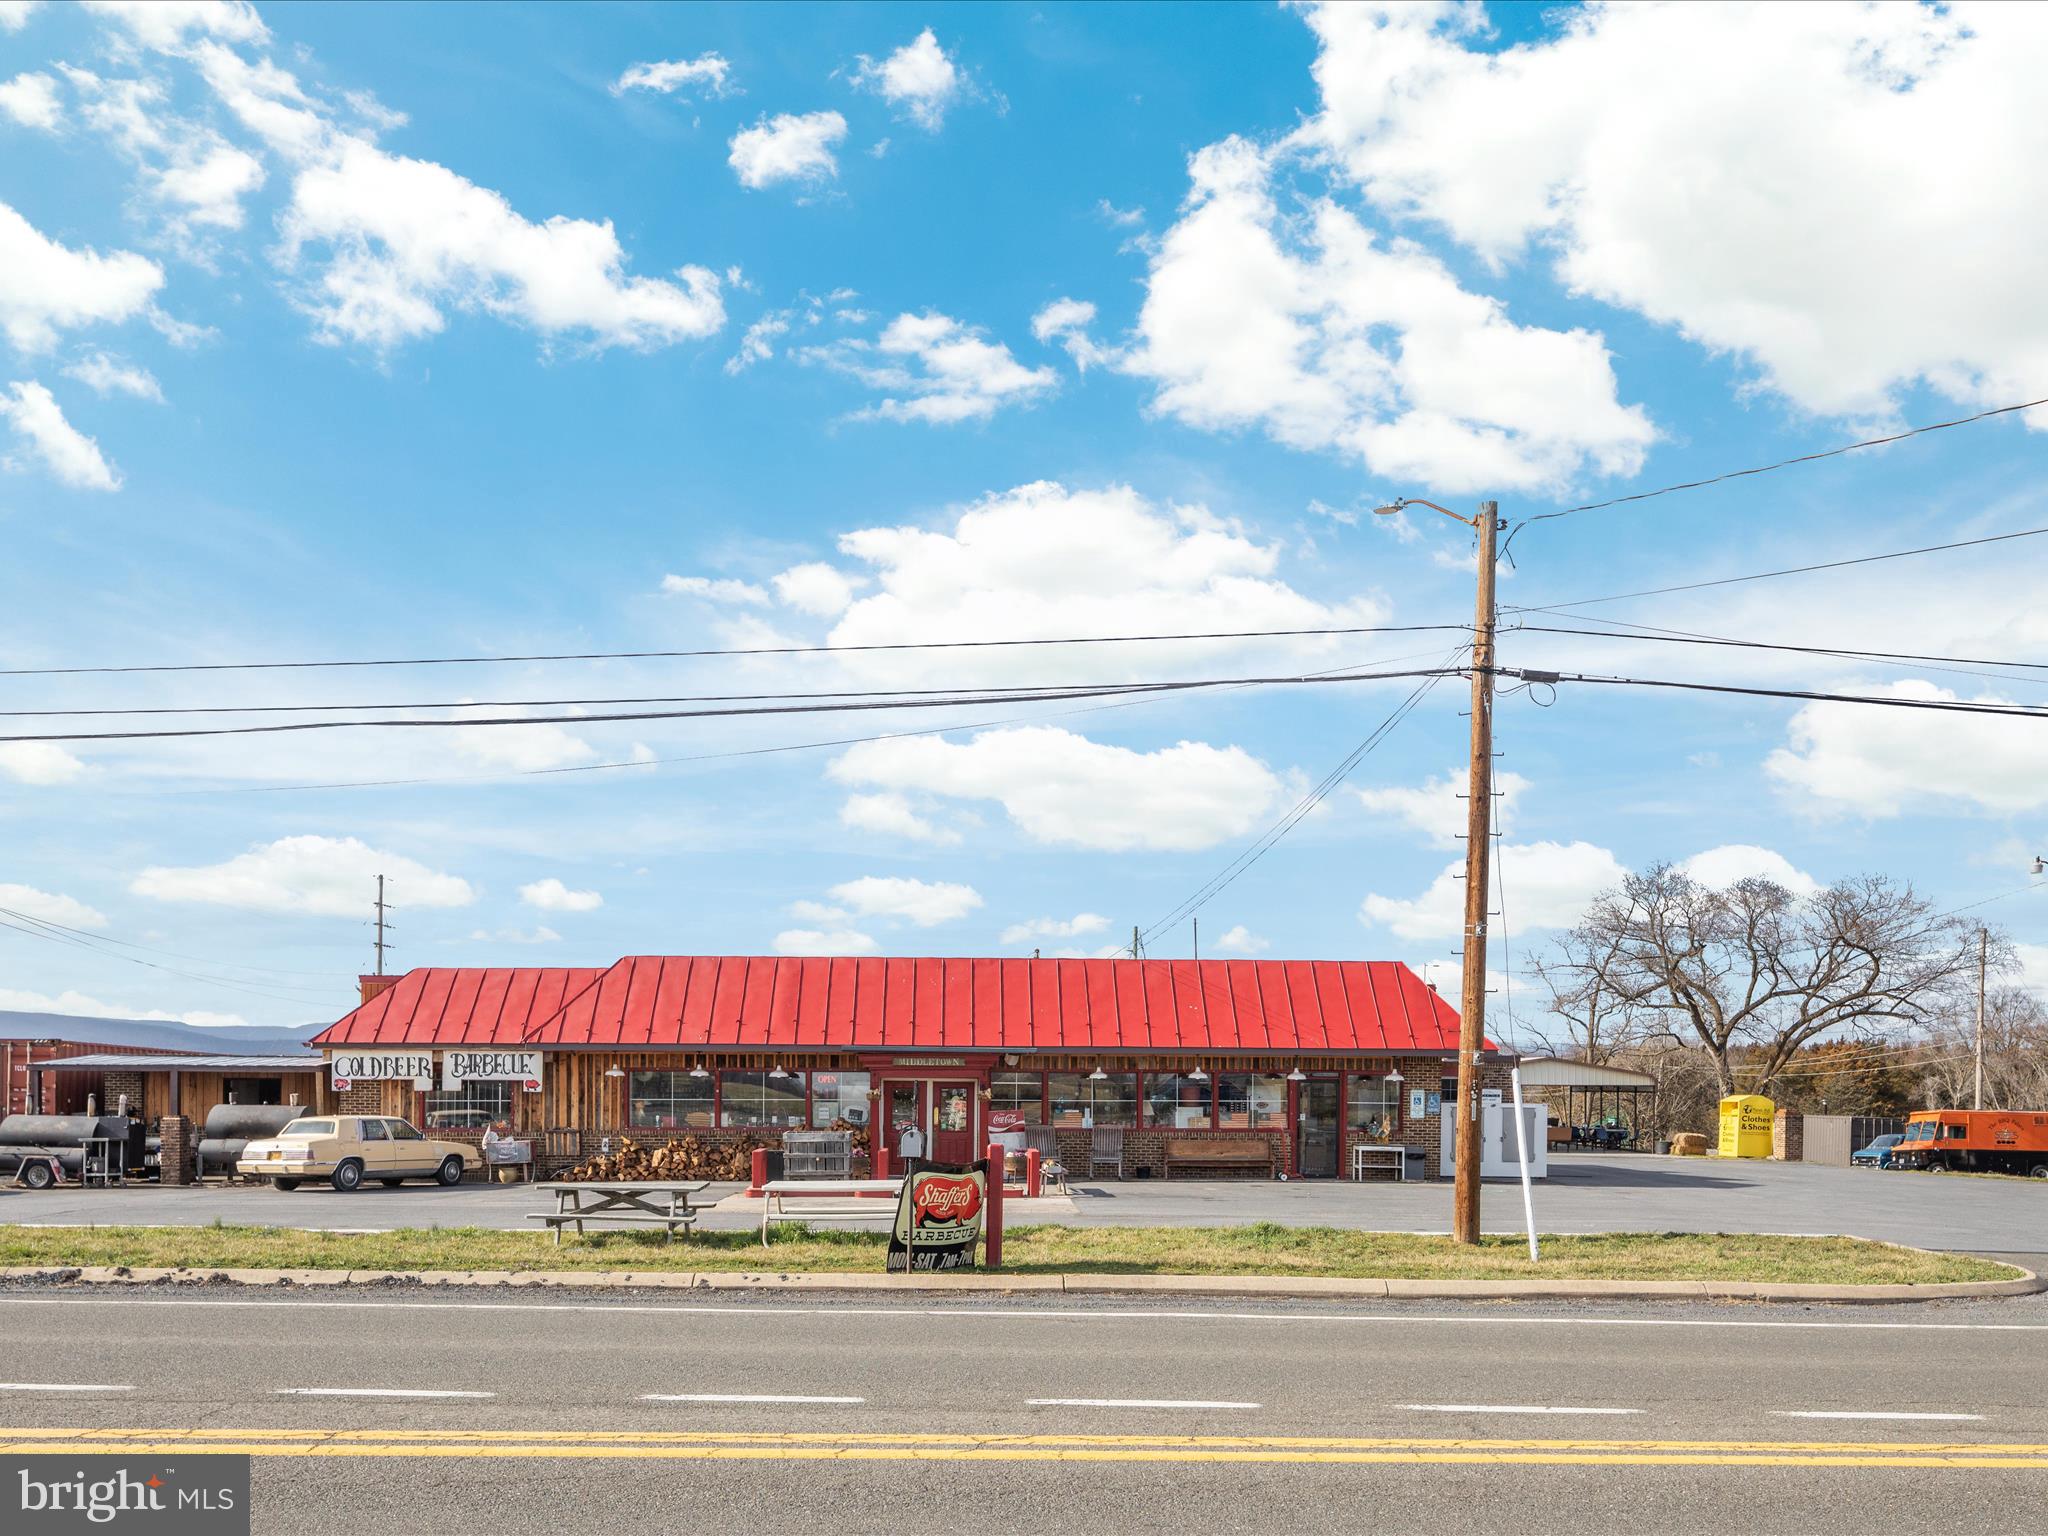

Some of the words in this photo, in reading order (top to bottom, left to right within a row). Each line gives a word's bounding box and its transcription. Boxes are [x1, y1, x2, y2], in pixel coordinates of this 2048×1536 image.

[450, 1053, 536, 1078] BARBECUE
[898, 1057, 960, 1066] MIDDLETOWN
[817, 1075, 837, 1084] OPEN
[992, 1113, 1017, 1125] Coca-Cola
[1741, 1115, 1771, 1123] Clothes
[1748, 1123, 1770, 1131] Shoes
